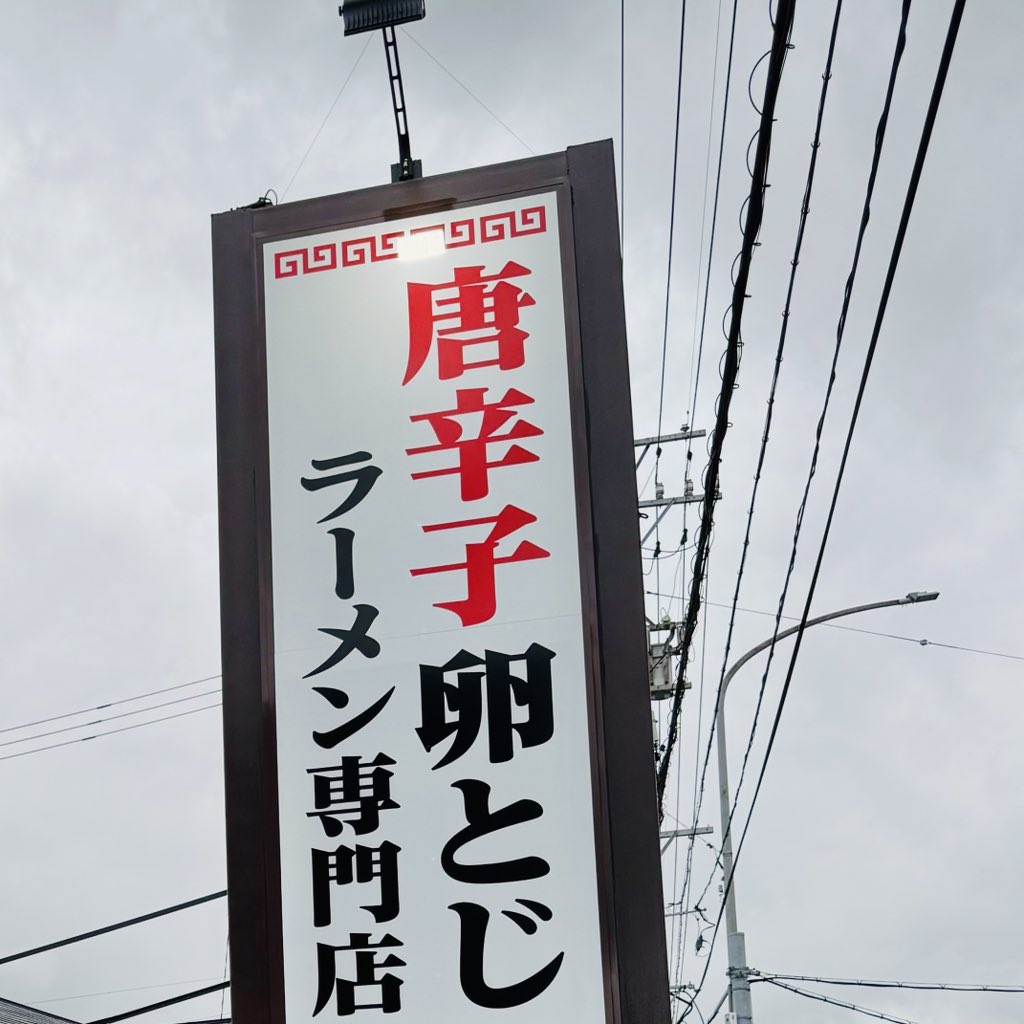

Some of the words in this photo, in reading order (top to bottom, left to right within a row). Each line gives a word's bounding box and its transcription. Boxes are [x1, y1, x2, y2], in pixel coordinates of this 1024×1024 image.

[300, 451, 407, 1017] ラーメン専門店
